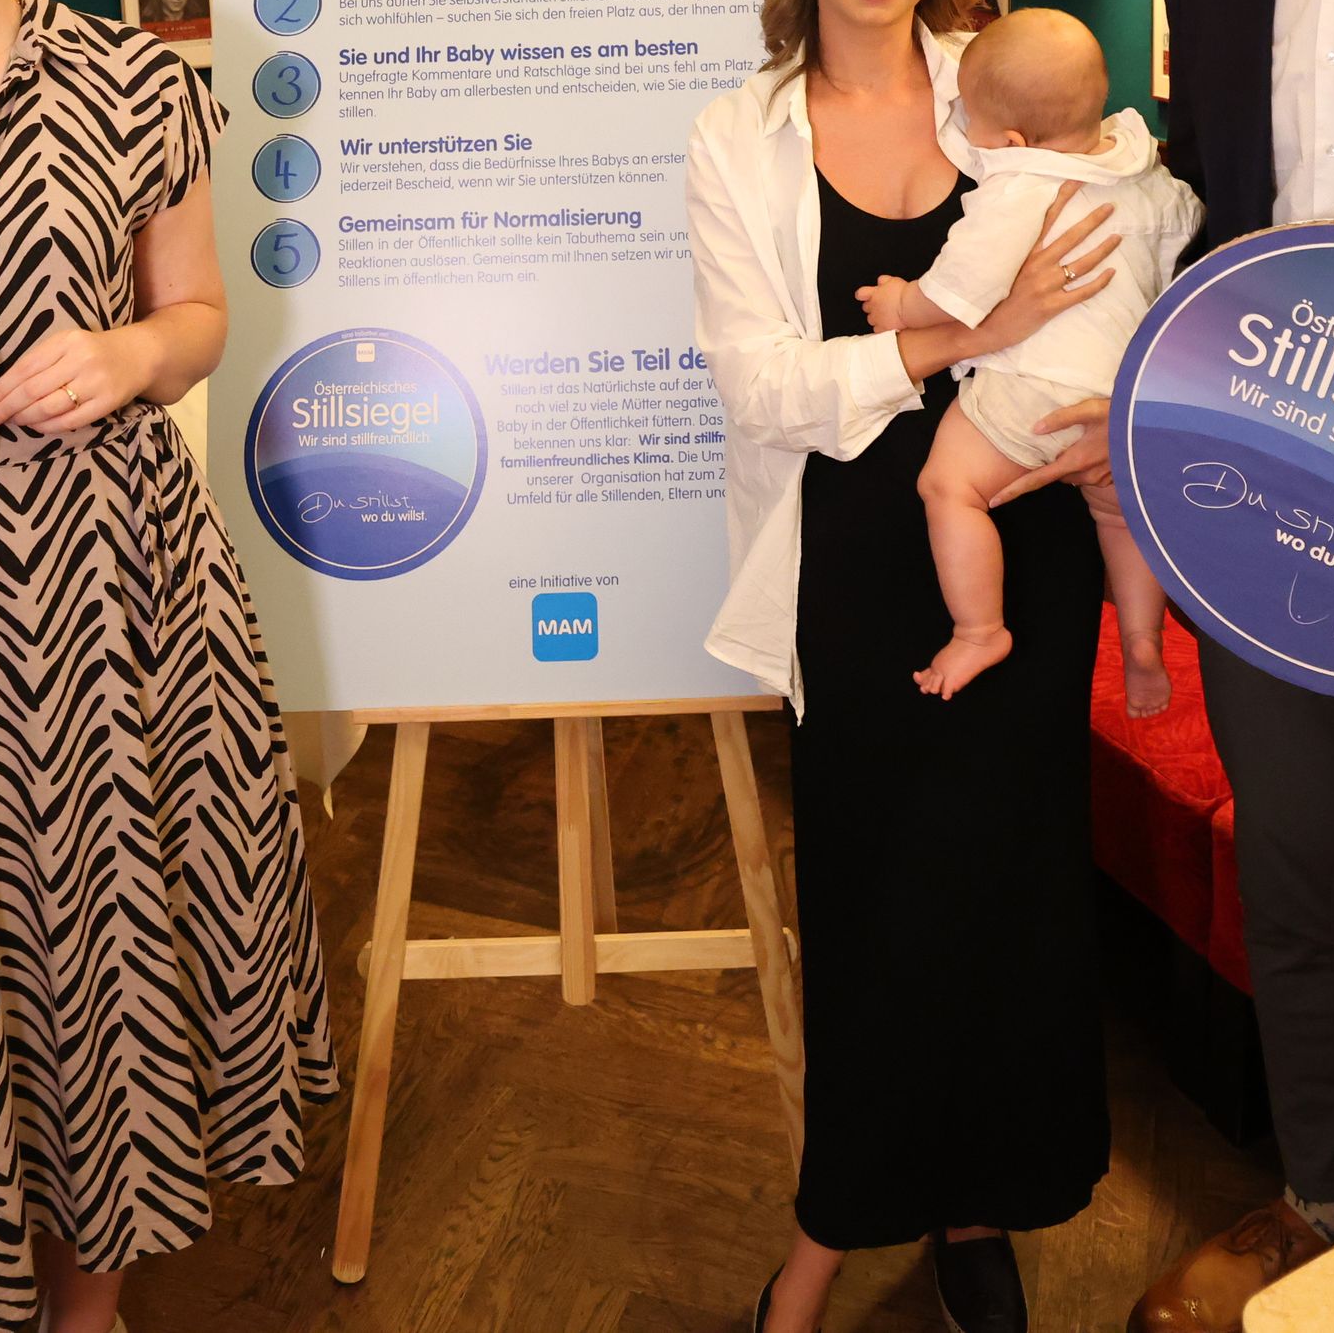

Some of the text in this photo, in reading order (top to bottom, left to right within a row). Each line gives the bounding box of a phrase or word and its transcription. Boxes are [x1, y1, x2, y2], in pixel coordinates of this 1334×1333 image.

[339, 40, 698, 65] Sie und Ihr Baby wissen es am besten
[271, 65, 303, 107] 3
[340, 134, 532, 155] Wir unterstützen Sie
[274, 149, 298, 190] 4
[338, 209, 641, 232] Gemeinsam für Normalisierung
[272, 233, 302, 275] 5
[484, 348, 669, 375] Werden Sie Teil
[314, 381, 418, 396] Österreichisches
[291, 394, 440, 433] Stillsiegel
[1229, 375, 1268, 409] Wir
[1271, 394, 1324, 435] sind
[507, 487, 701, 504] Umfeld für alle Stillenden, Eltern
[1181, 462, 1267, 509] Du
[1275, 526, 1307, 552] wo
[509, 575, 618, 588] eine Initiative von
[537, 618, 593, 637] MAM
